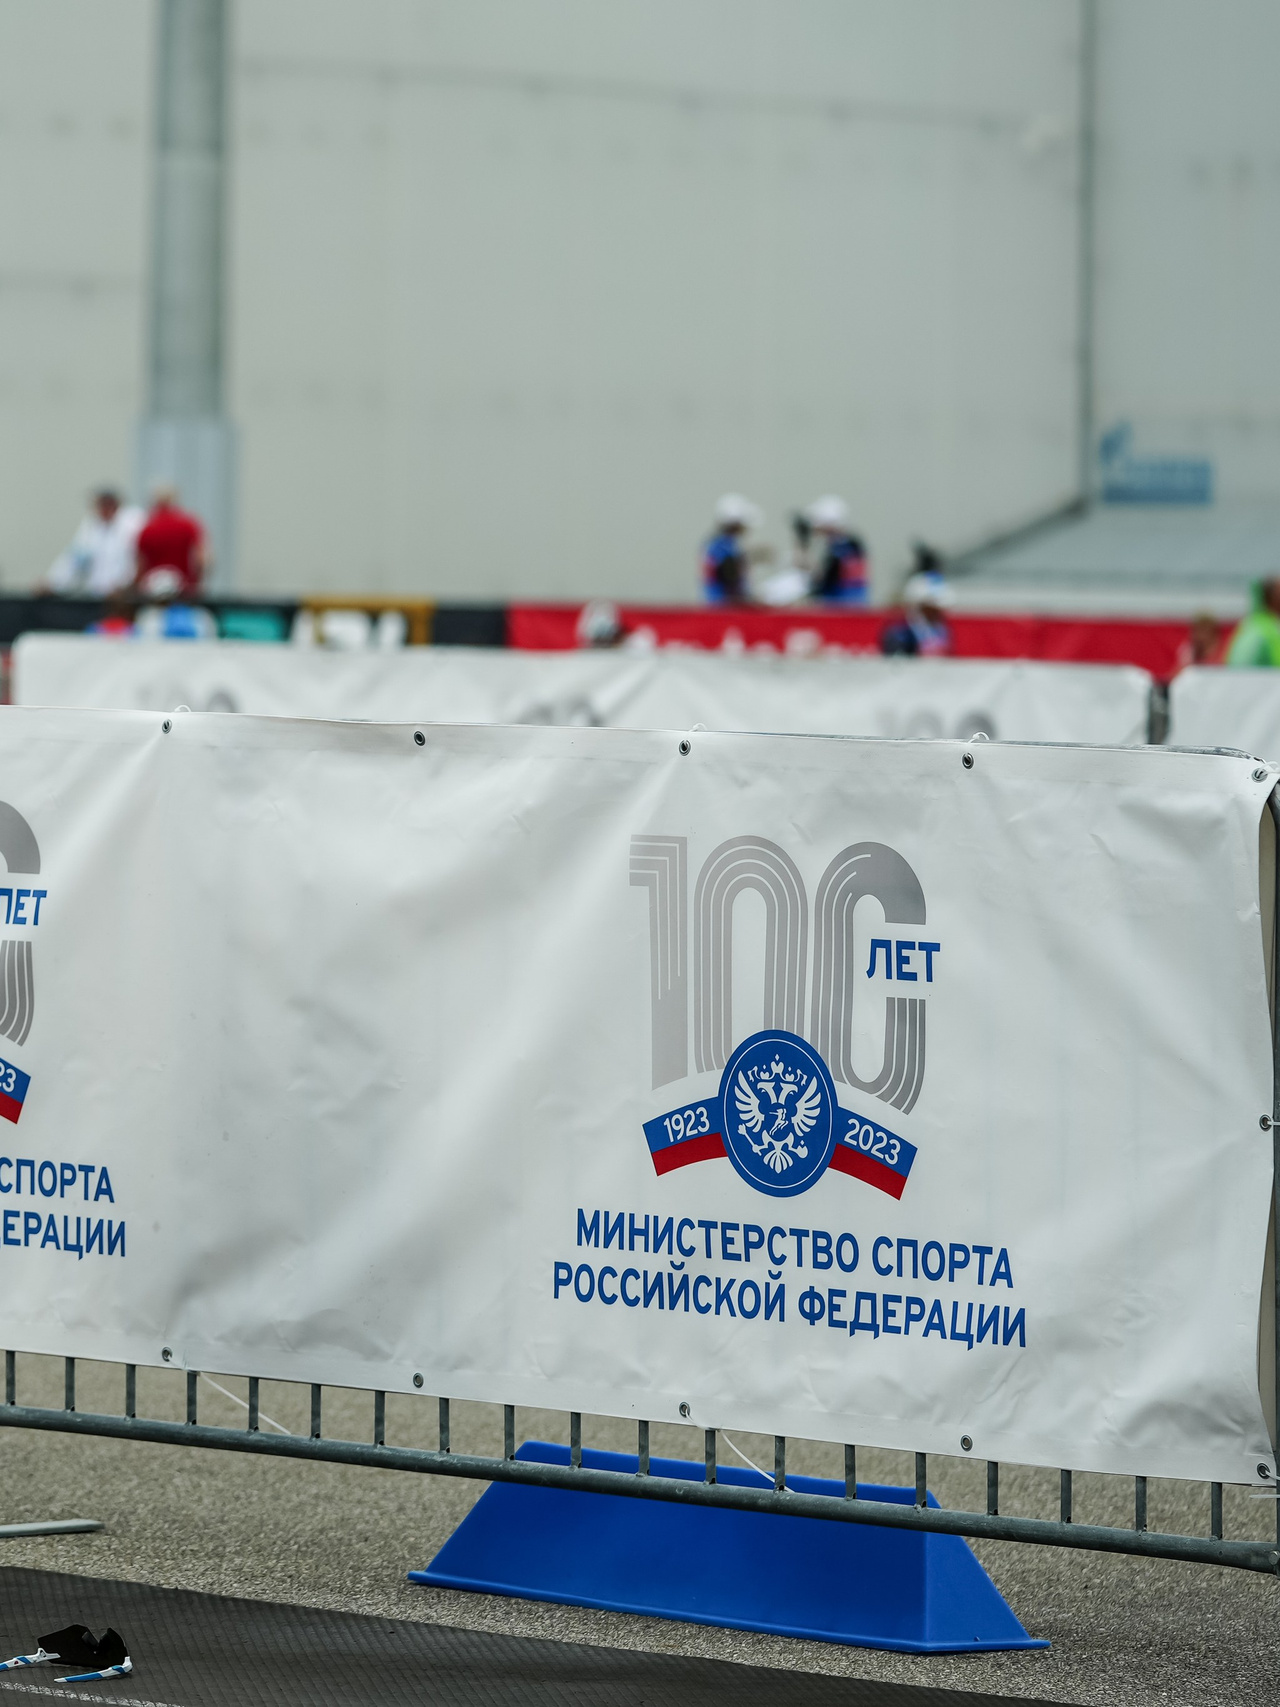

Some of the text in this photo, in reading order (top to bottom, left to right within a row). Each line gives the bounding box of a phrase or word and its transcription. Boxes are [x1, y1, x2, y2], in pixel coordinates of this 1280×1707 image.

[865, 938, 941, 983] ЛЕТ
[663, 1106, 711, 1143] 1923
[843, 1119, 902, 1166] 2023
[576, 1208, 1014, 1289] МИНИСТЕРСТВО СПОРТА
[553, 1261, 1026, 1352] РОССИЙСКОЙ ФЕДЕРАЦИИ
